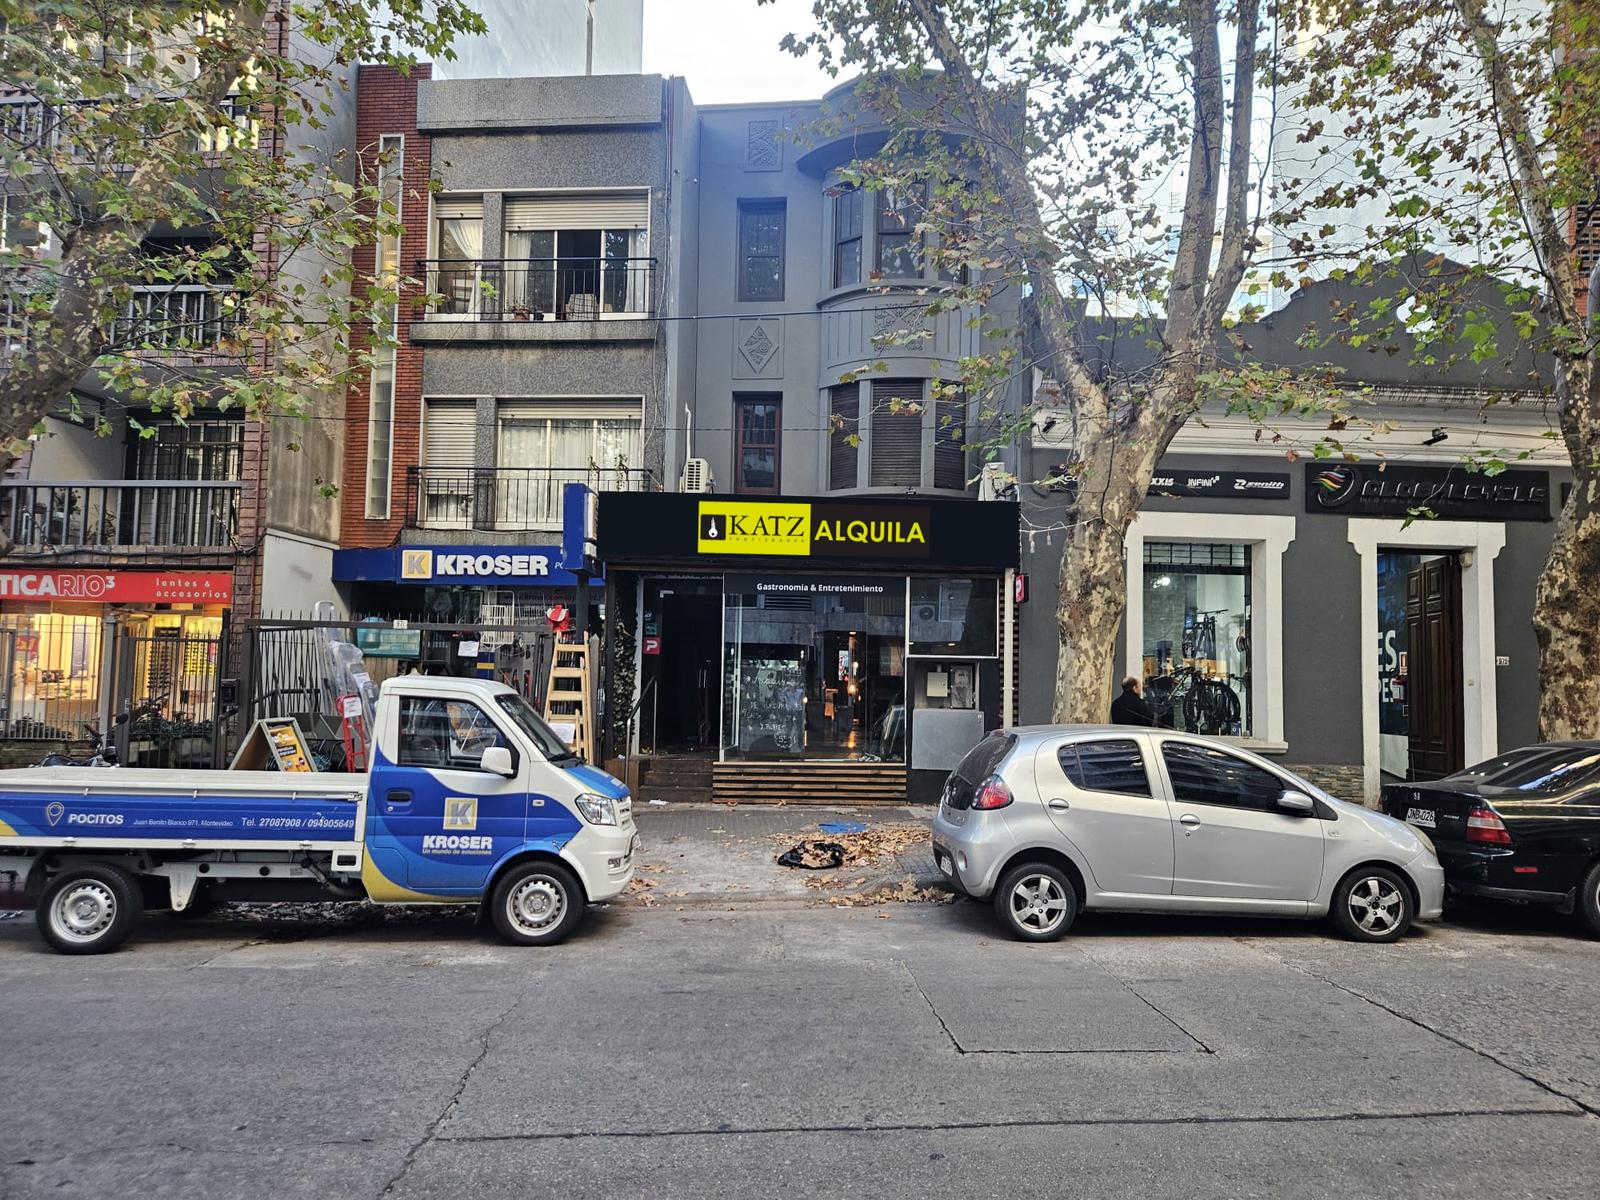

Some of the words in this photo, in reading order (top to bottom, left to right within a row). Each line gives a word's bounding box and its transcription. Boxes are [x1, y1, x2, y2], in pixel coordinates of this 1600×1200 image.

[728, 515, 805, 536] KATZ
[814, 520, 926, 544] ALQUILA
[437, 554, 549, 576] KROSER
[156, 577, 198, 587] lentes
[204, 580, 211, 588] &
[810, 584, 817, 592] &
[818, 584, 884, 593] Entretenimiento
[156, 589, 228, 598] accesorios
[68, 813, 124, 825] POCITOS
[241, 817, 256, 827] Tel.
[259, 817, 301, 828] 27087908
[422, 835, 493, 849] KROSER
